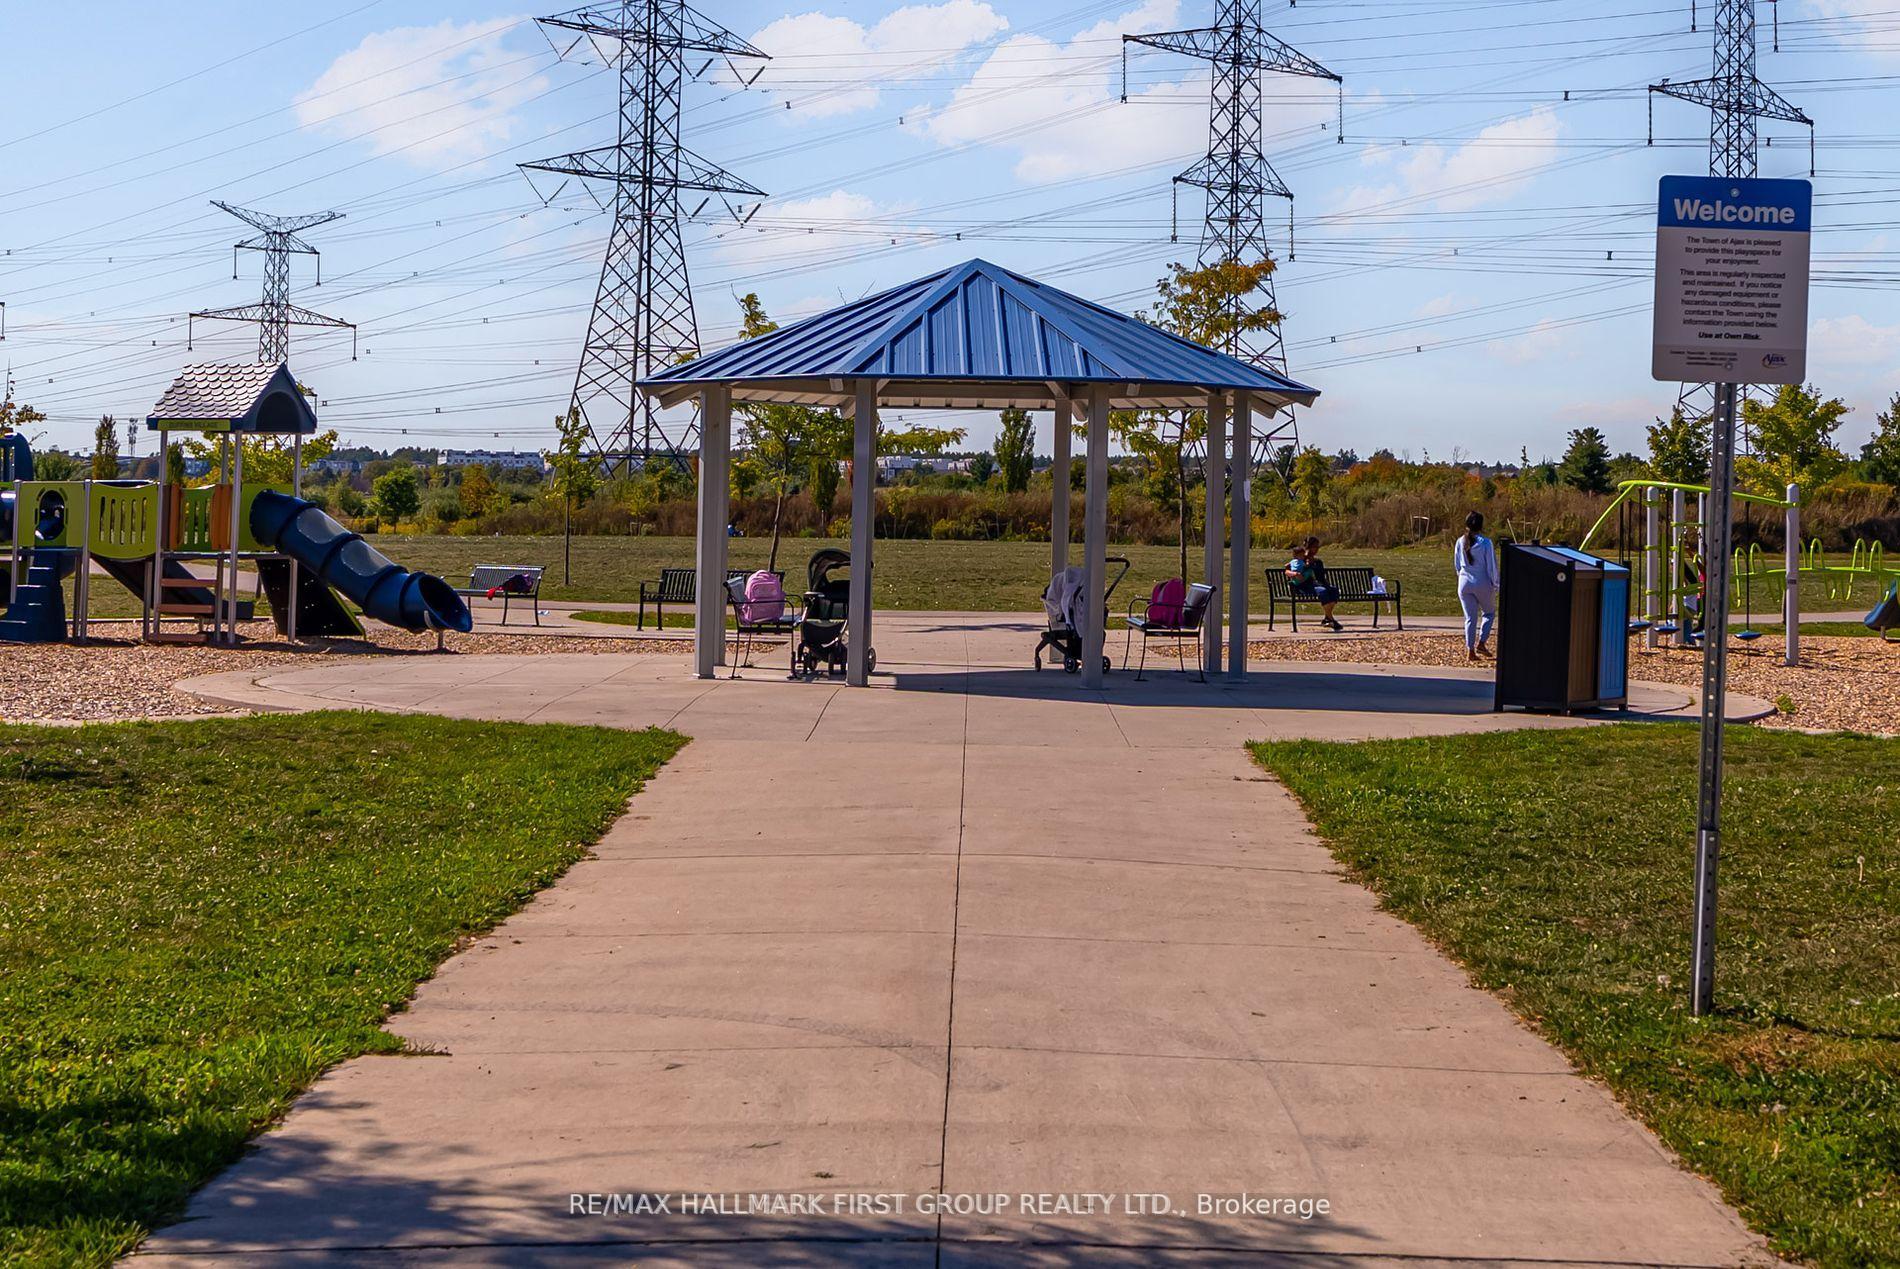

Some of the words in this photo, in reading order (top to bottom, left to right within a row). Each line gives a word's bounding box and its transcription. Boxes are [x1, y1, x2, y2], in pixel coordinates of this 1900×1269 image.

[1674, 198, 1795, 224] Welcome
[1702, 236, 1720, 244] Town
[1730, 238, 1744, 246] Ajax
[1754, 239, 1781, 248] pleased
[1694, 247, 1720, 256] provide
[1735, 248, 1770, 258] playspace
[1722, 258, 1760, 266] enjoyment.
[1720, 270, 1750, 279] regularly
[1751, 270, 1786, 279] inspected
[1698, 290, 1731, 298] damaged
[1733, 291, 1770, 299] equipment
[1719, 300, 1757, 308] conditions,
[1745, 311, 1764, 319] using
[1763, 353, 1786, 365] Ajax
